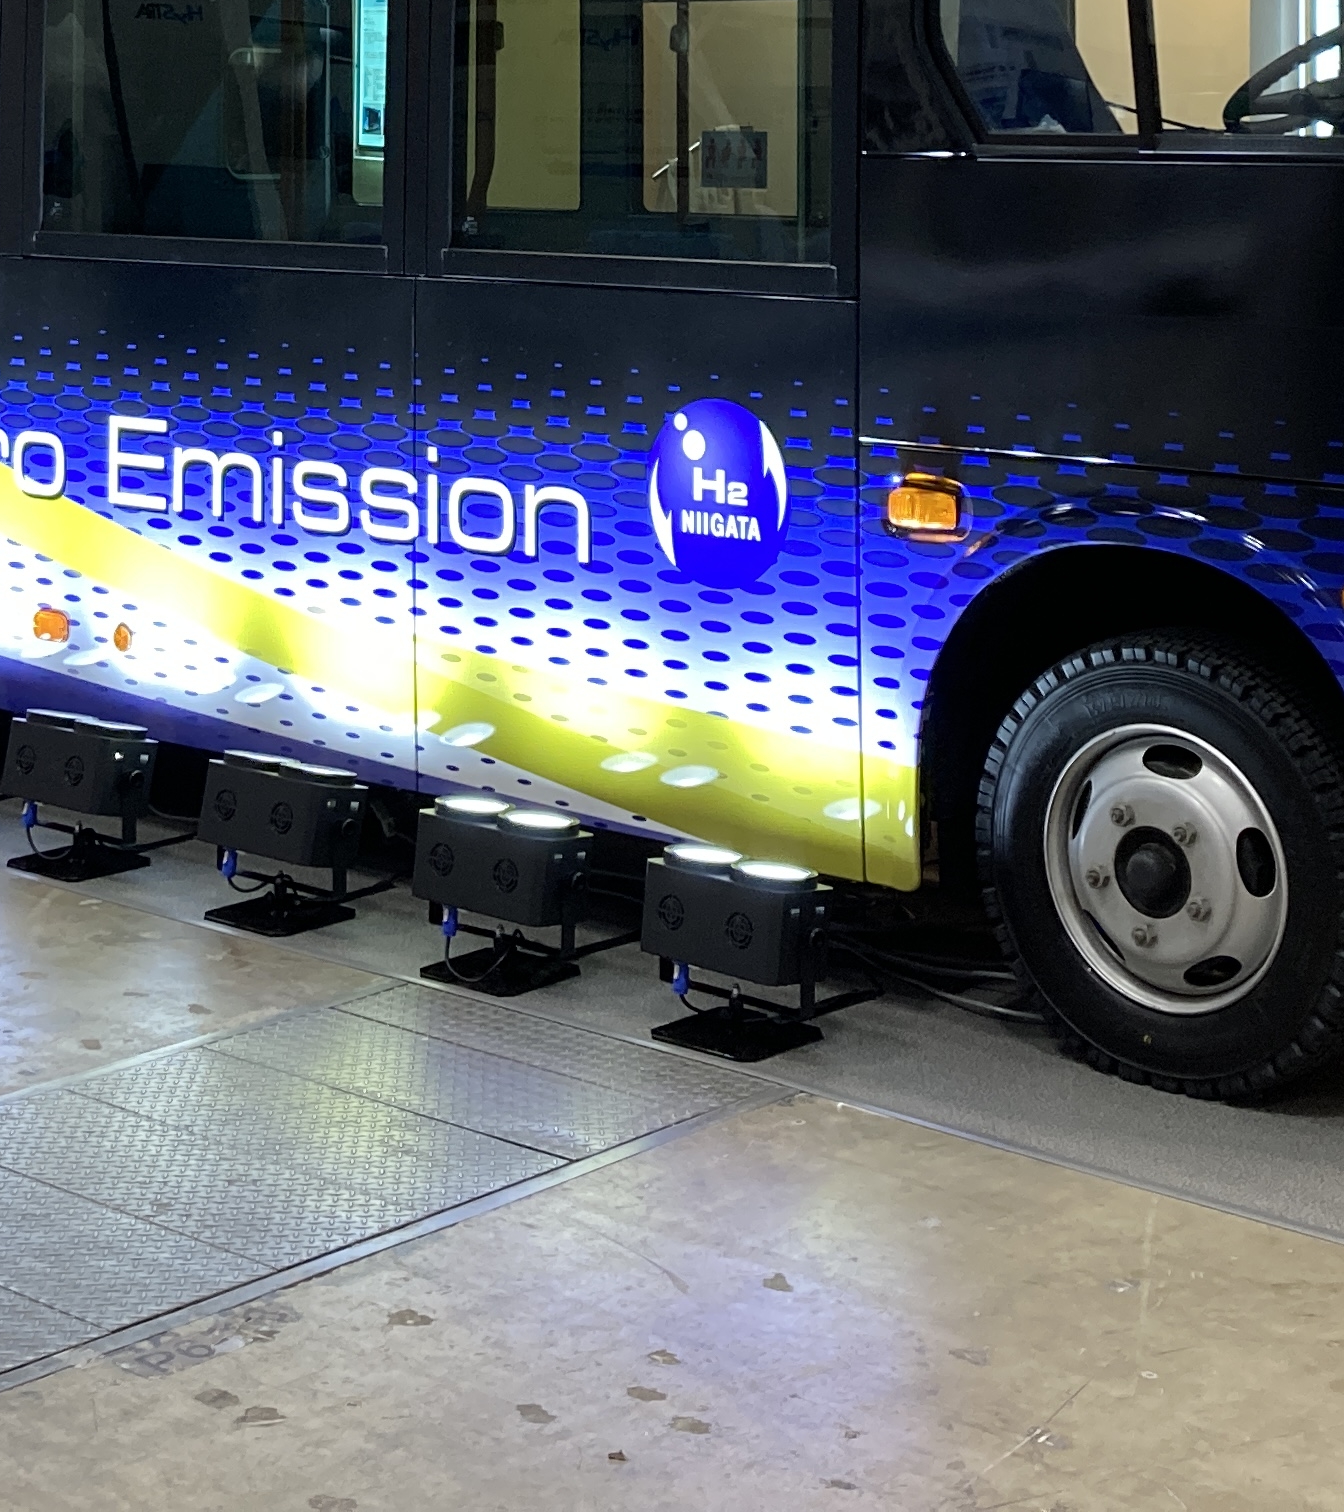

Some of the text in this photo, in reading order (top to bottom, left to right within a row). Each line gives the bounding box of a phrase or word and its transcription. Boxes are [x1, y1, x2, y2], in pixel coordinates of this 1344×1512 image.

[108, 415, 592, 564] Emission
[693, 466, 748, 507] H2
[681, 509, 761, 542] NIIGATA
